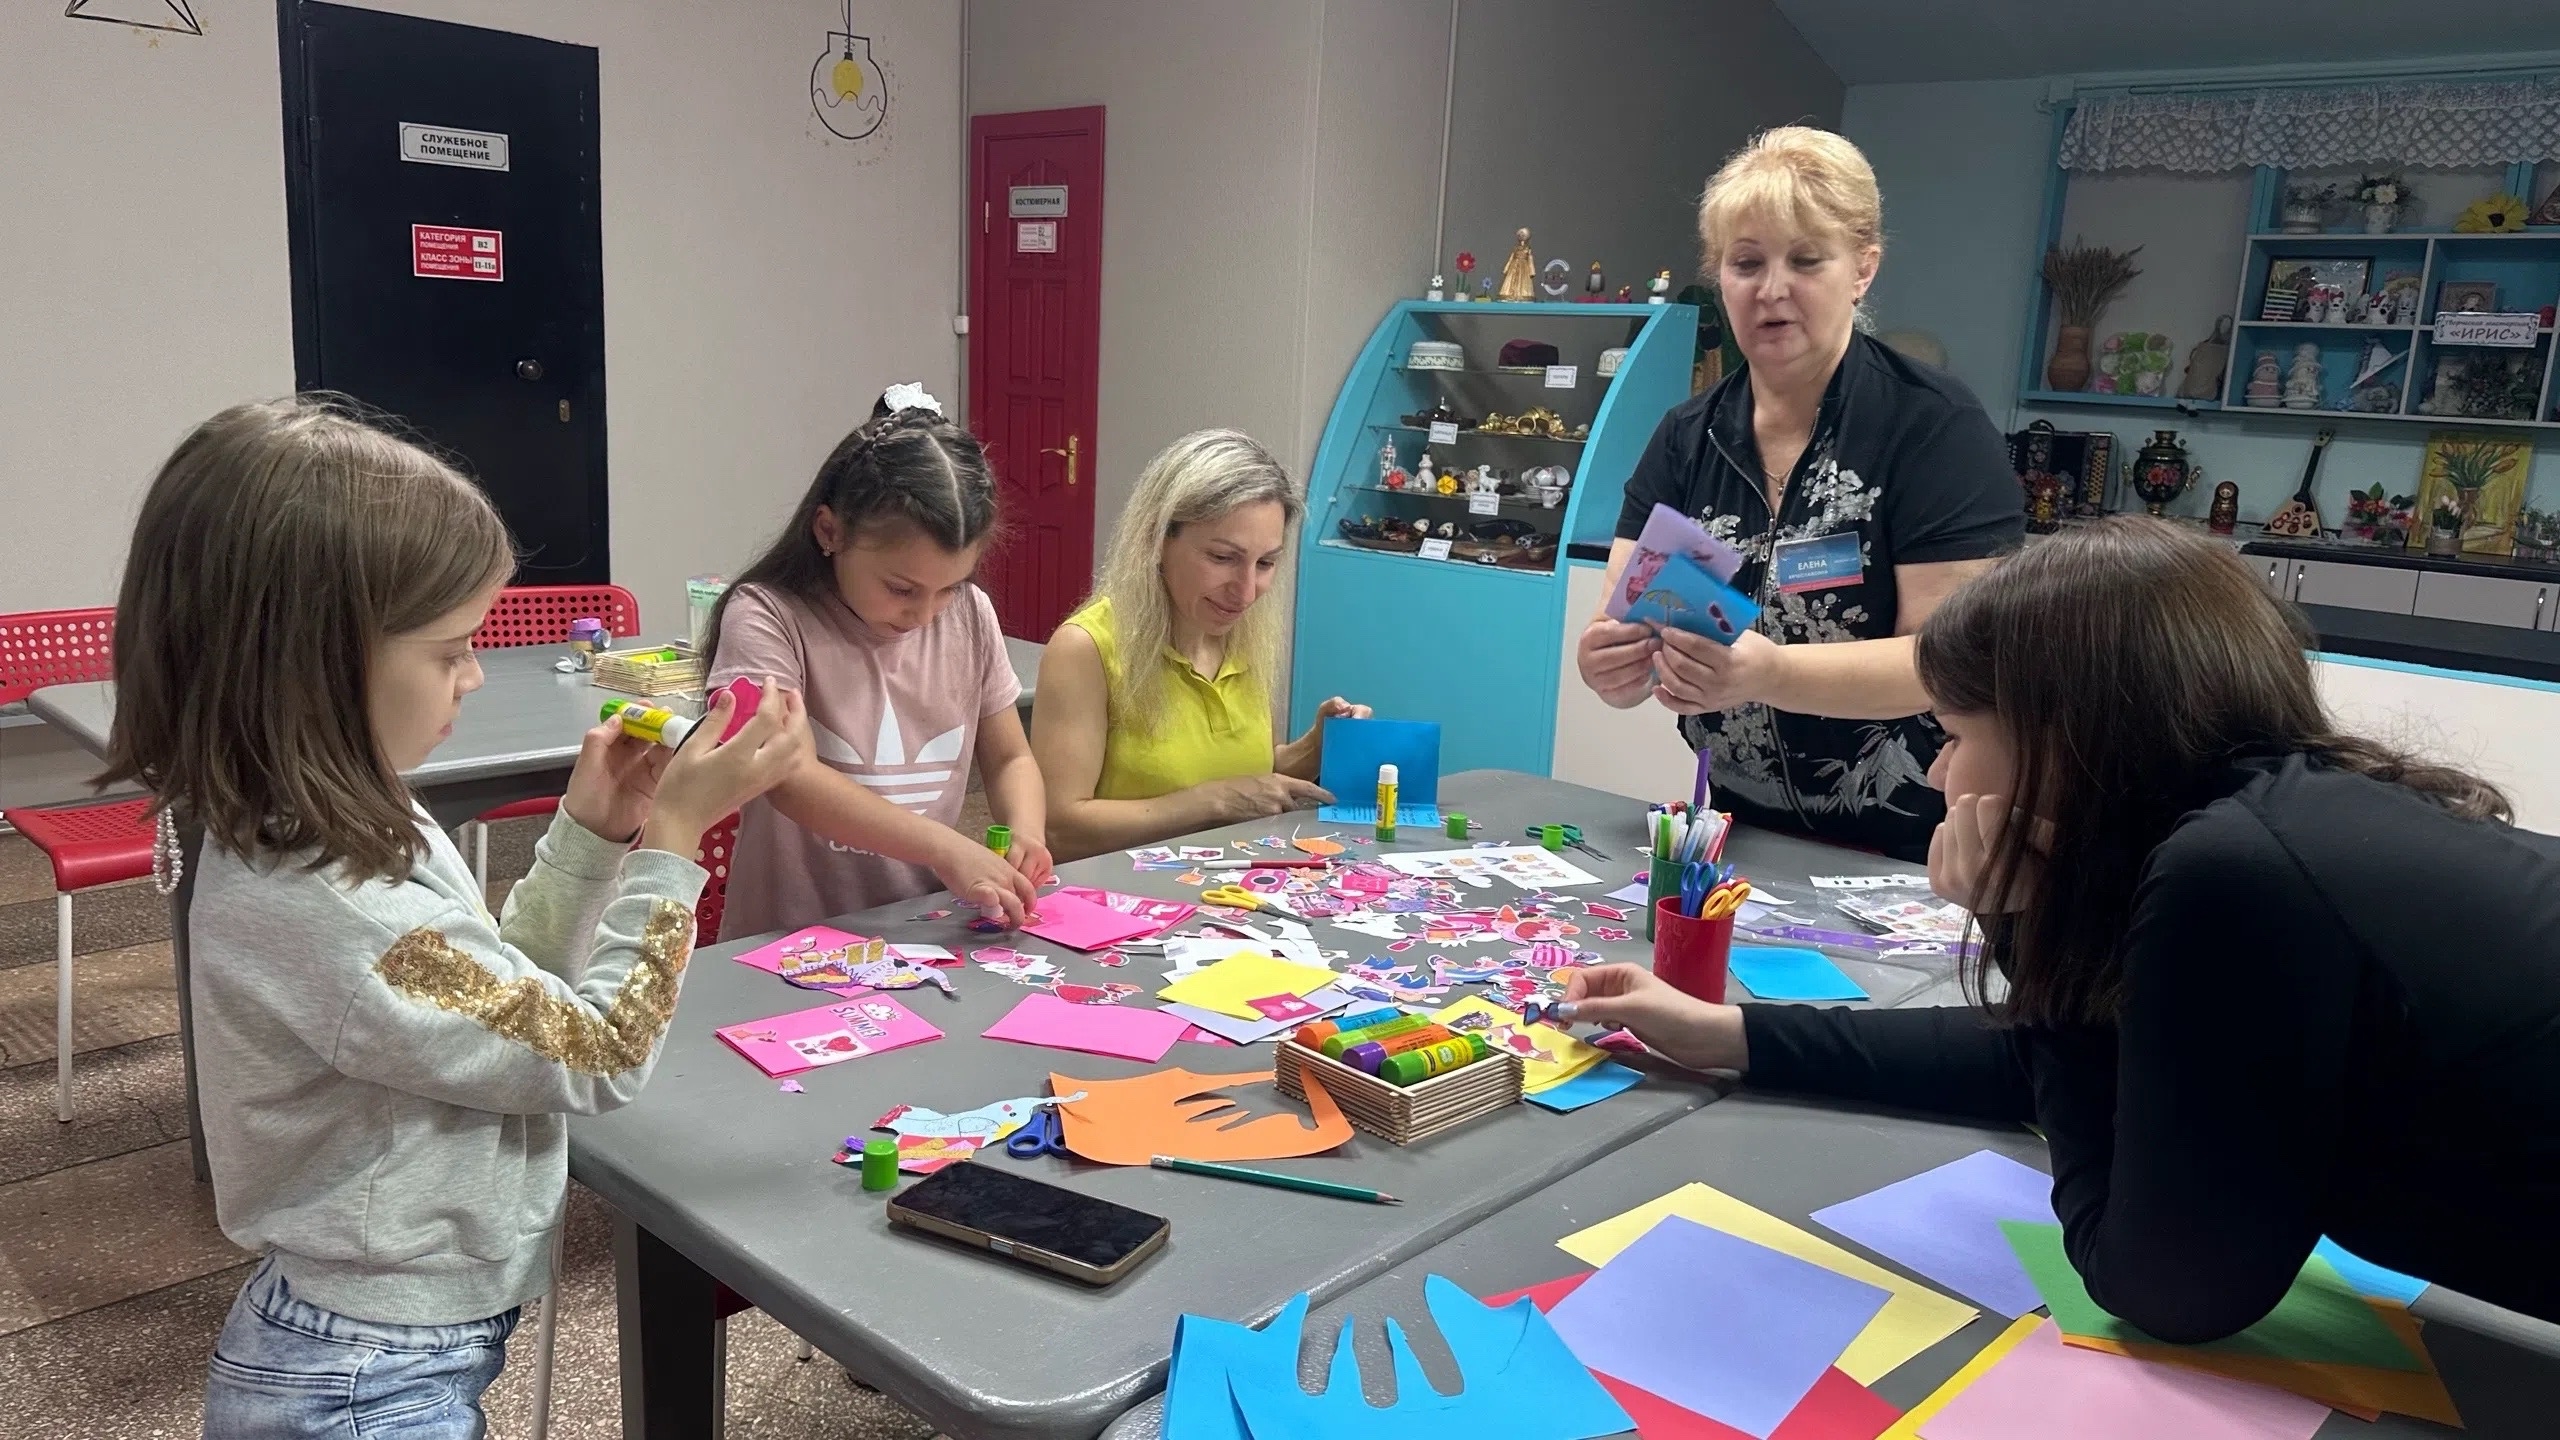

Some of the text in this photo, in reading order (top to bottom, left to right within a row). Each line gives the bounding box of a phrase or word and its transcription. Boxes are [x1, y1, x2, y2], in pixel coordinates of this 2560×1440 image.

[421, 133, 489, 149] СЛУЖЕБНОЕ
[420, 145, 491, 160] ПОМЕЩЕНИЕ
[419, 231, 467, 243] КАТЕГОРИЯ
[420, 252, 473, 264] КЛАСС ЗОНЫ
[2449, 327, 2521, 340] «ИРИС»
[1797, 559, 1828, 571] ЕЛЕНА
[832, 1006, 886, 1037] SUMMER
